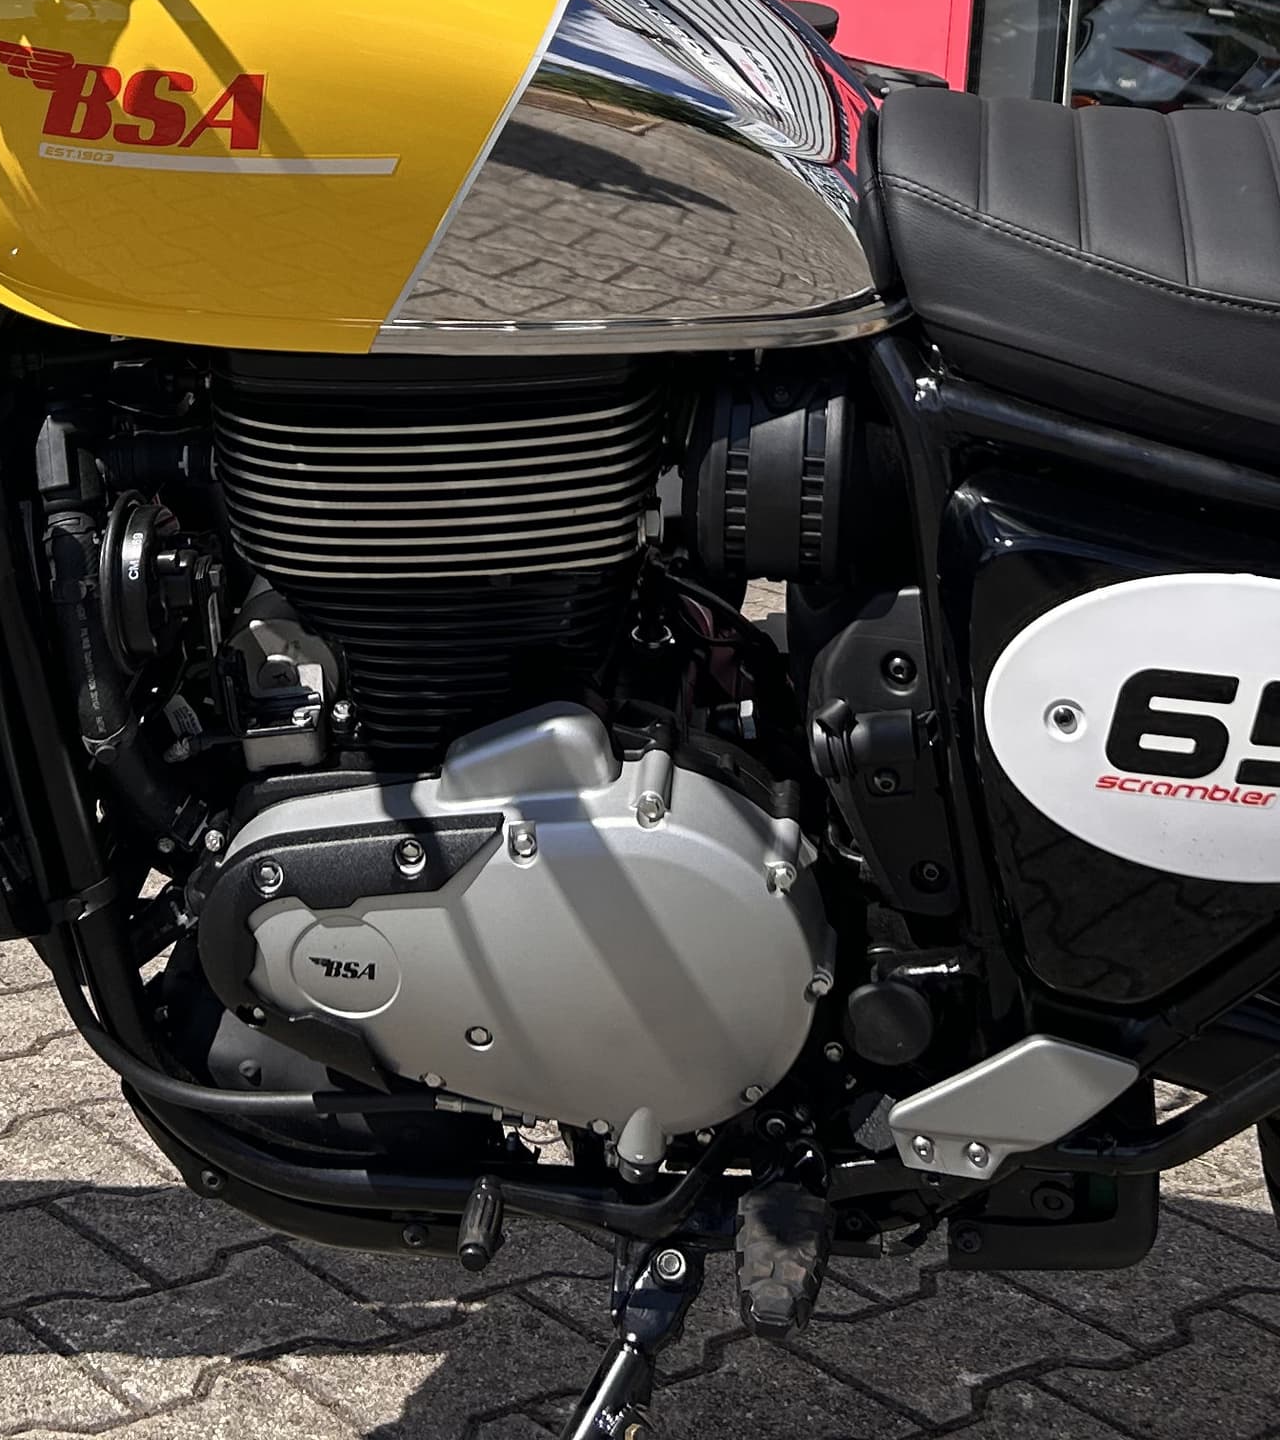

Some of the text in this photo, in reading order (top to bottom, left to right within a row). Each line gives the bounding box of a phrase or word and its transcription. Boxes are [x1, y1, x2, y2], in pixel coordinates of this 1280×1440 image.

[41, 62, 267, 151] BSA
[1094, 773, 1278, 807] scrambler
[322, 958, 377, 981] BSA
